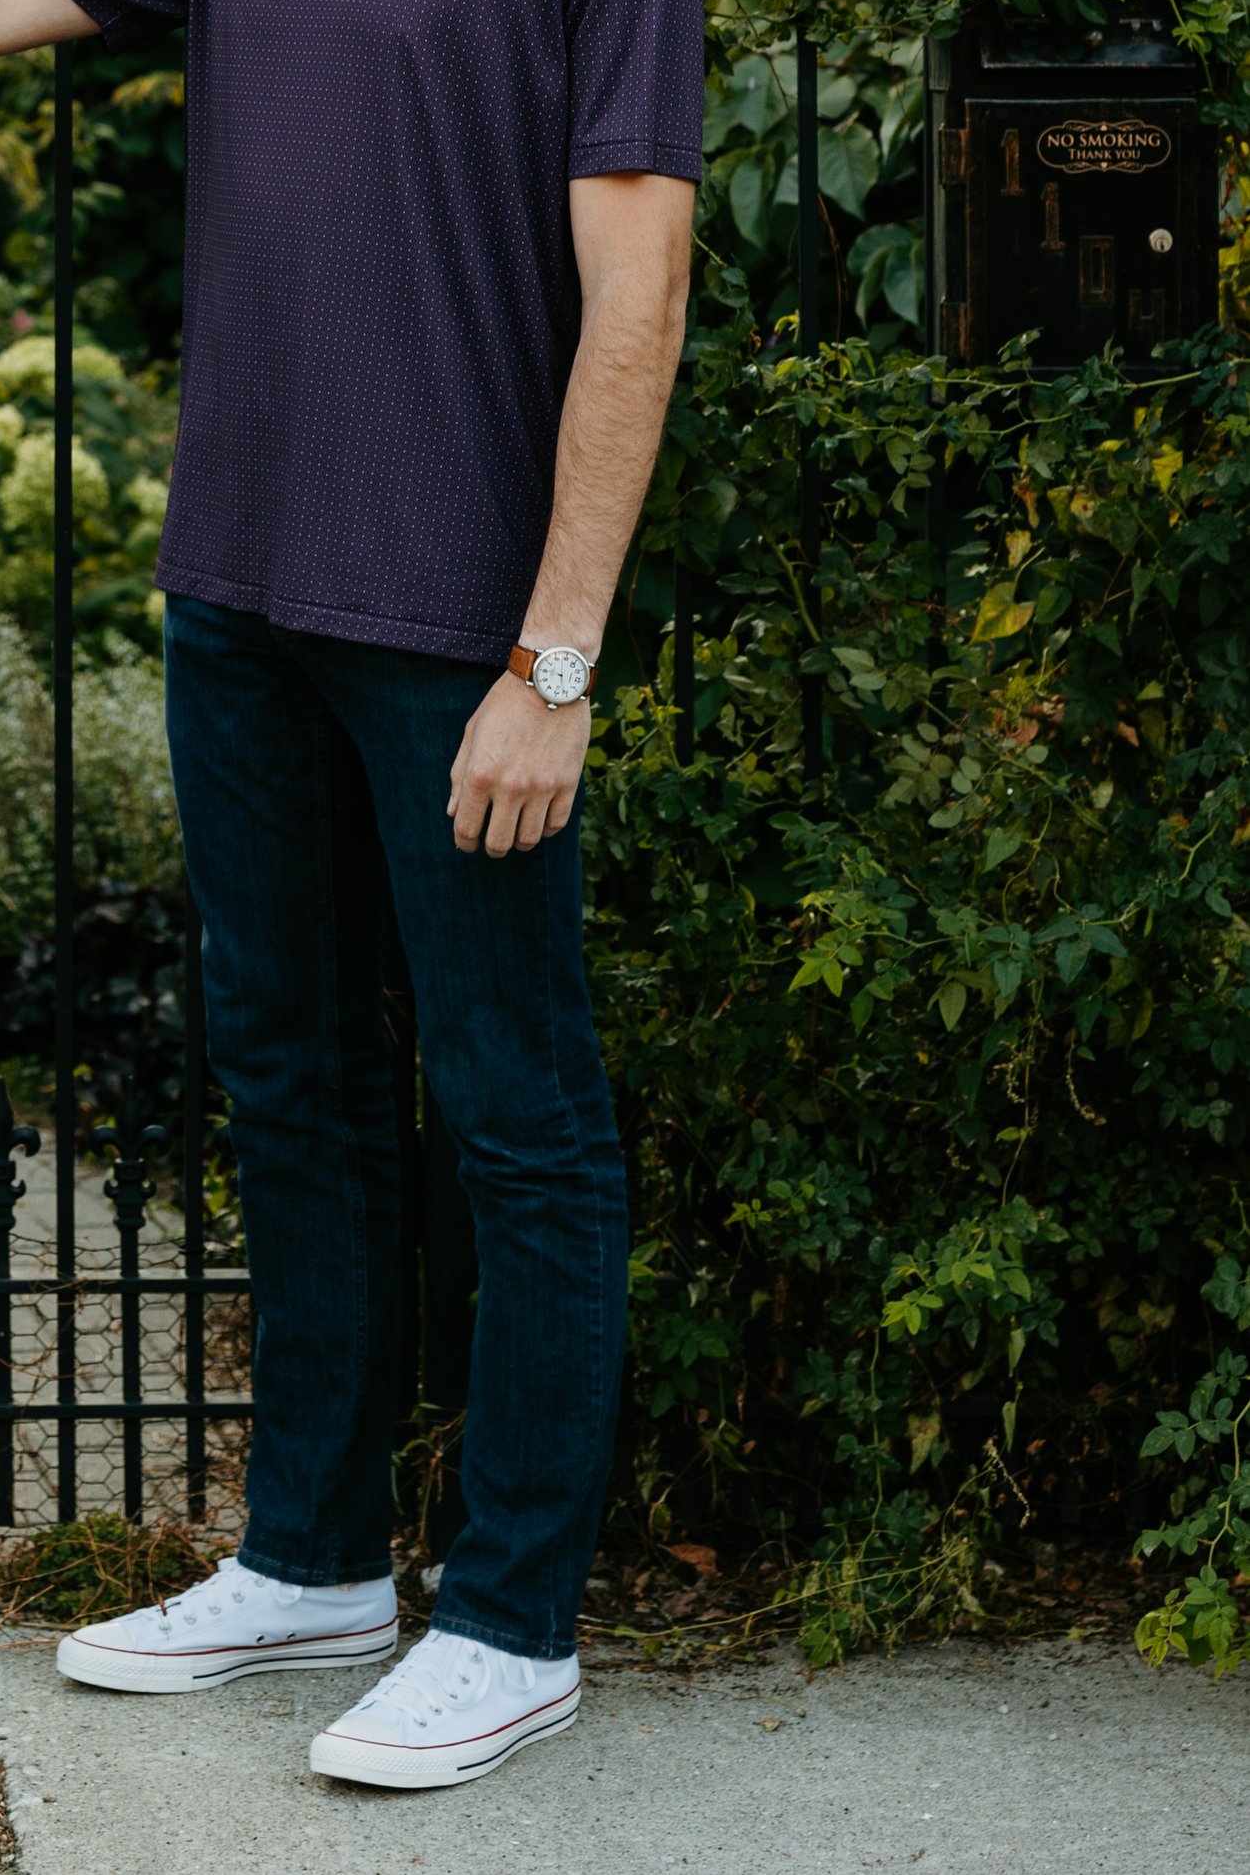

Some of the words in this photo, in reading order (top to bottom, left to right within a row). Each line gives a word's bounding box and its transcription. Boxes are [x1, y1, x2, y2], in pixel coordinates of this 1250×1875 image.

[1047, 133, 1075, 147] NO
[1079, 133, 1161, 147] SMOKING
[1068, 148, 1112, 160] THANK
[1115, 149, 1141, 160] YOU
